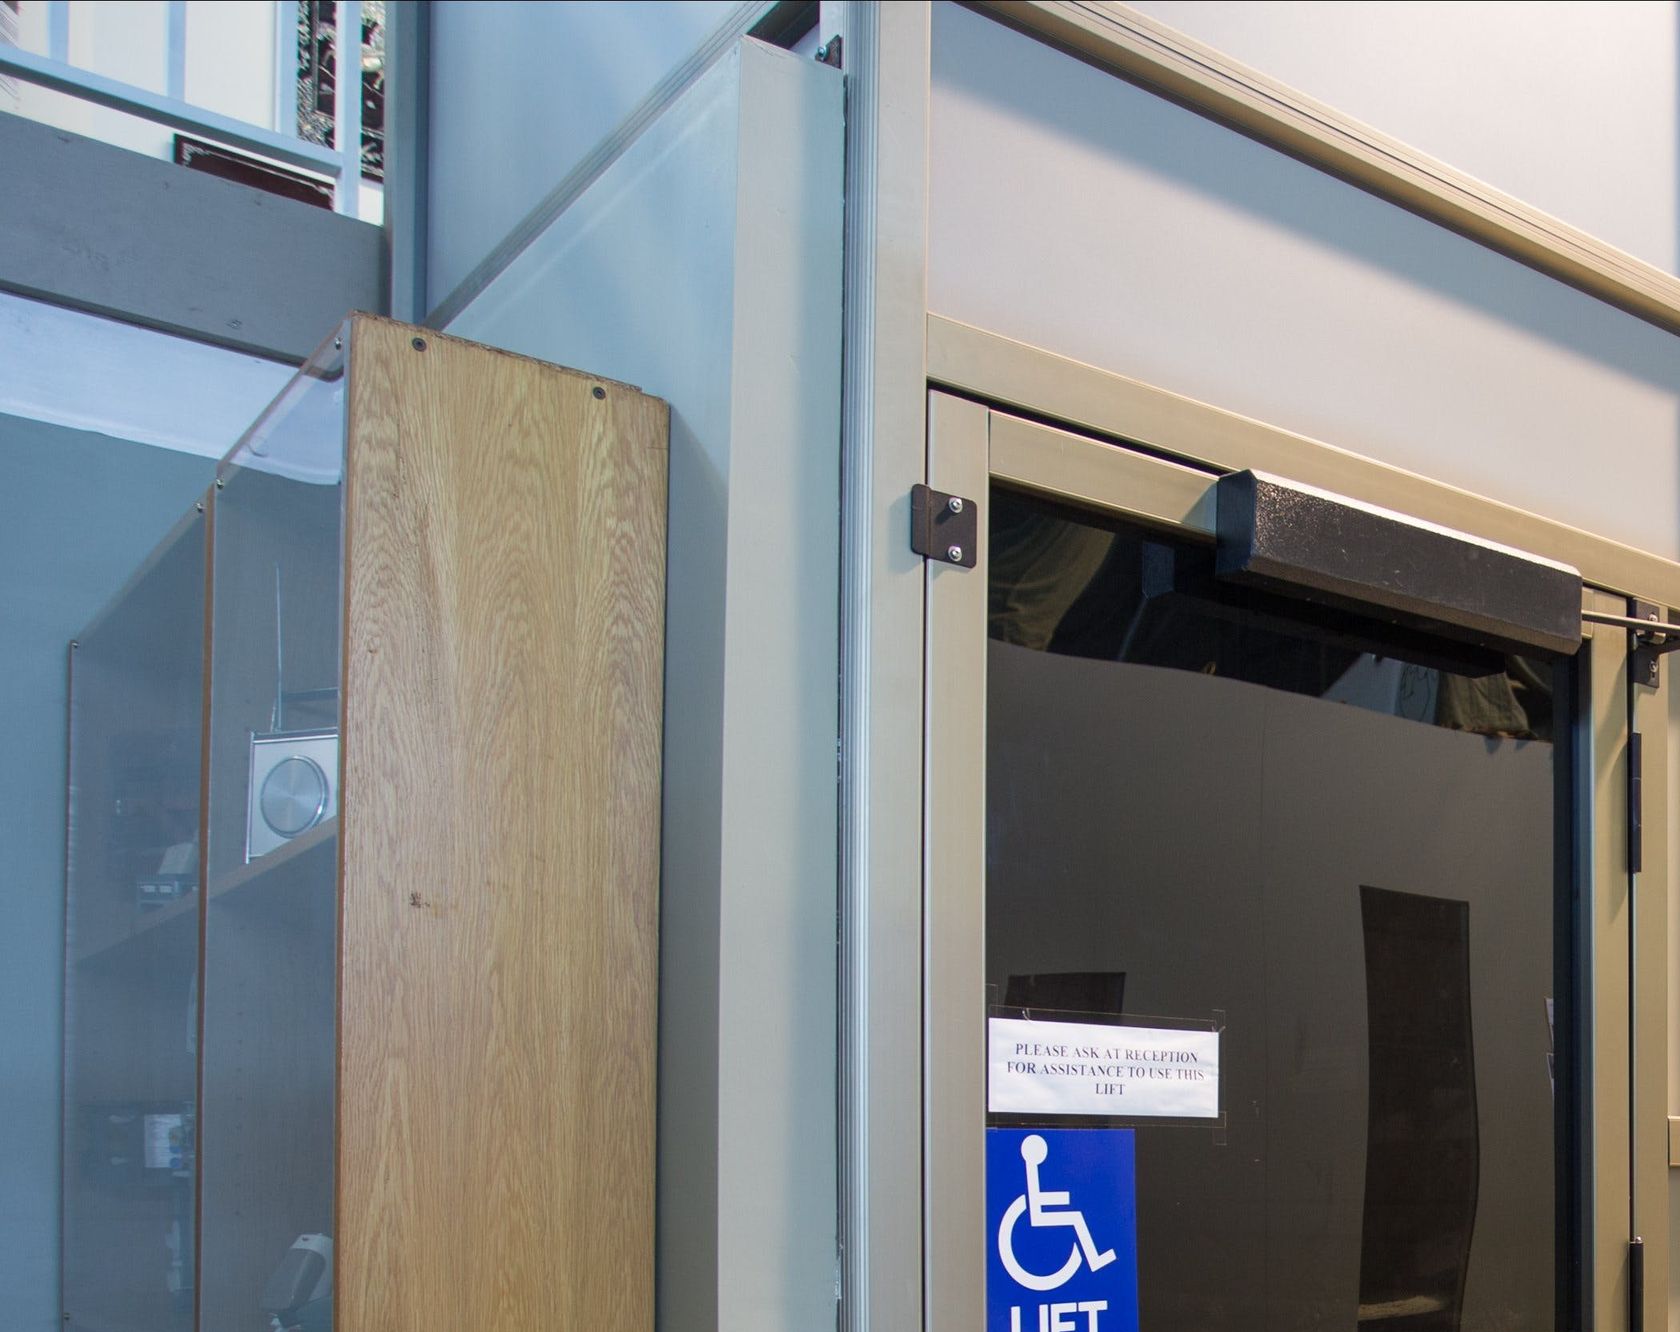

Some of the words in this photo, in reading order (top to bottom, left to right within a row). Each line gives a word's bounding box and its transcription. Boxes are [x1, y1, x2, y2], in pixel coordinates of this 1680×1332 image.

[1015, 1043, 1069, 1057] PLEASE
[1073, 1047, 1100, 1059] ASK
[1103, 1048, 1121, 1060] AT
[1125, 1049, 1199, 1063] RECEPTION
[1007, 1061, 1036, 1074] FOR
[1040, 1062, 1125, 1078] ASSISTANCE
[1127, 1066, 1146, 1079] TO
[1149, 1067, 1173, 1080] USE
[1176, 1068, 1205, 1081] THIS
[1095, 1083, 1126, 1095] LIFT
